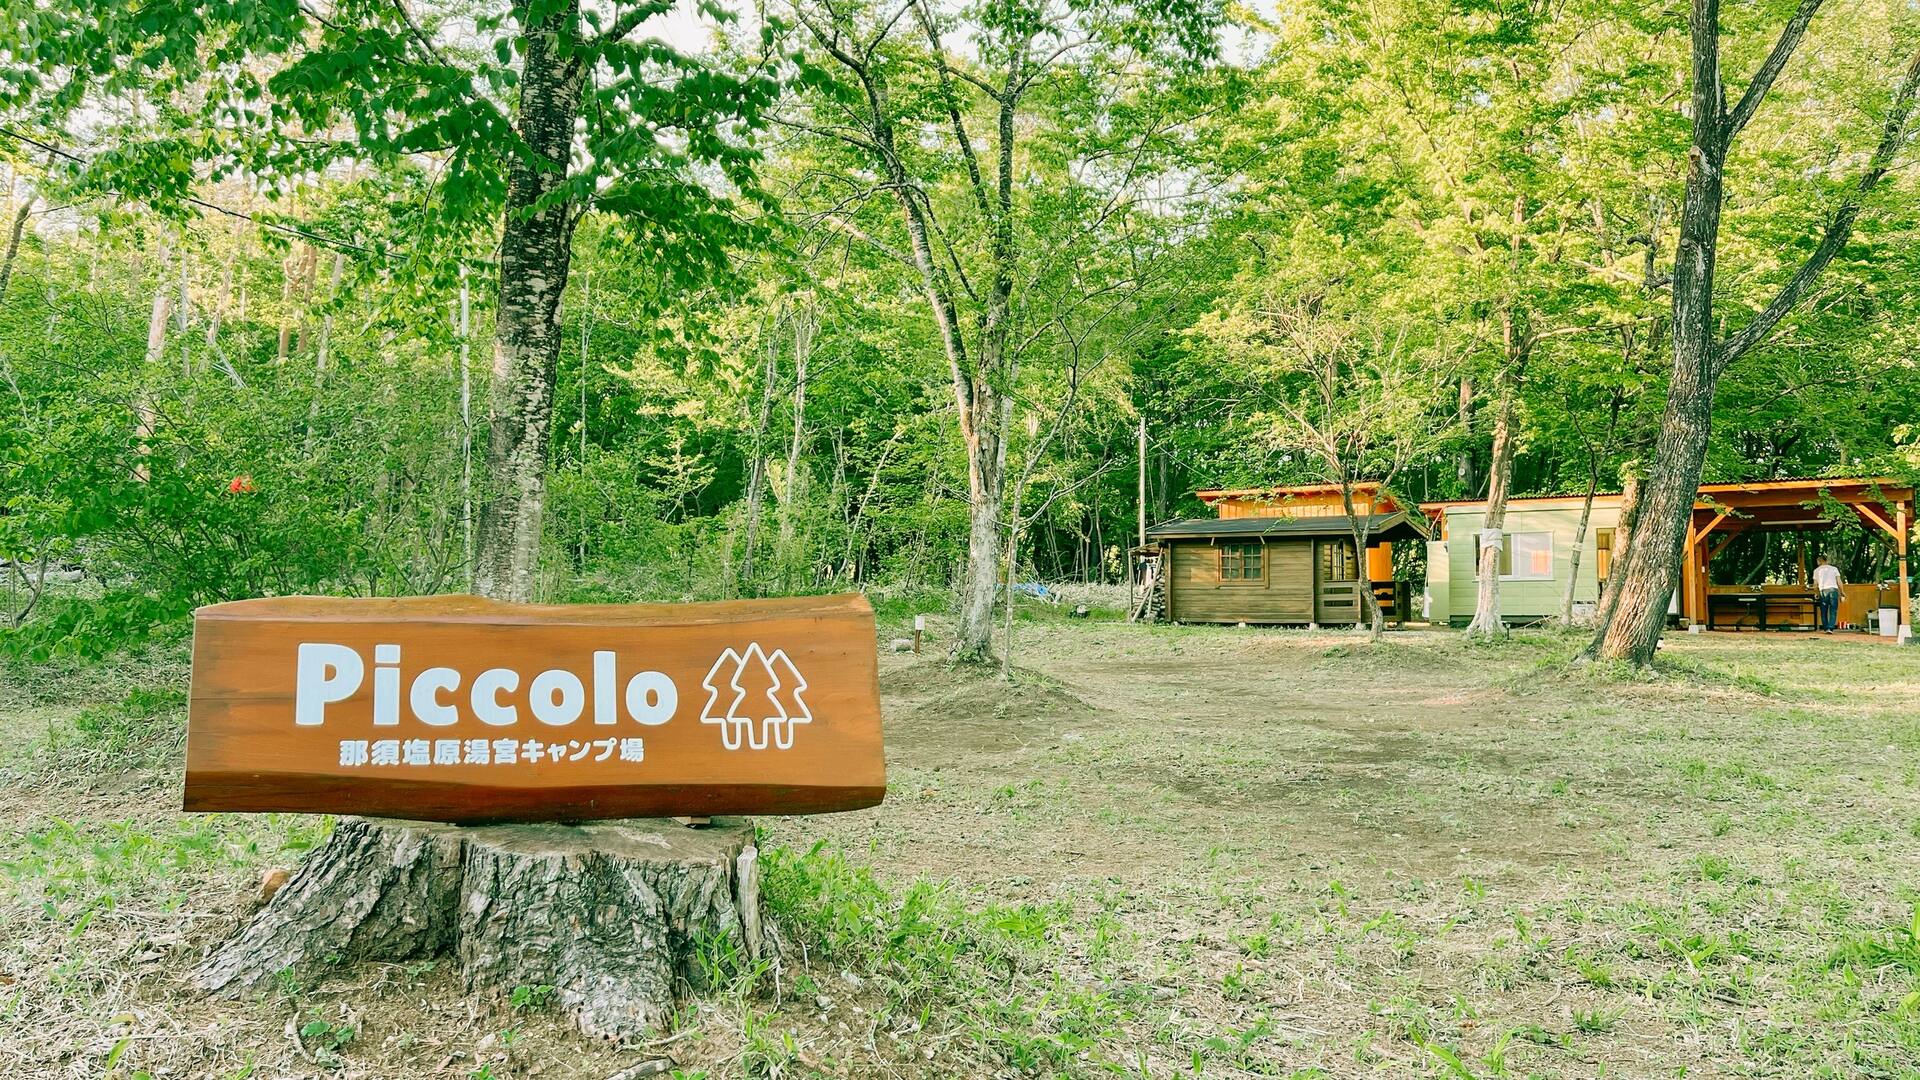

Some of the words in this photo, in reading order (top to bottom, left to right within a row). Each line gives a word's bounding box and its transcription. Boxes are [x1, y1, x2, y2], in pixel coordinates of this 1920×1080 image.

[295, 643, 678, 726] Piccolo
[339, 739, 645, 766] 那須塩原湯宮キャンプ場
